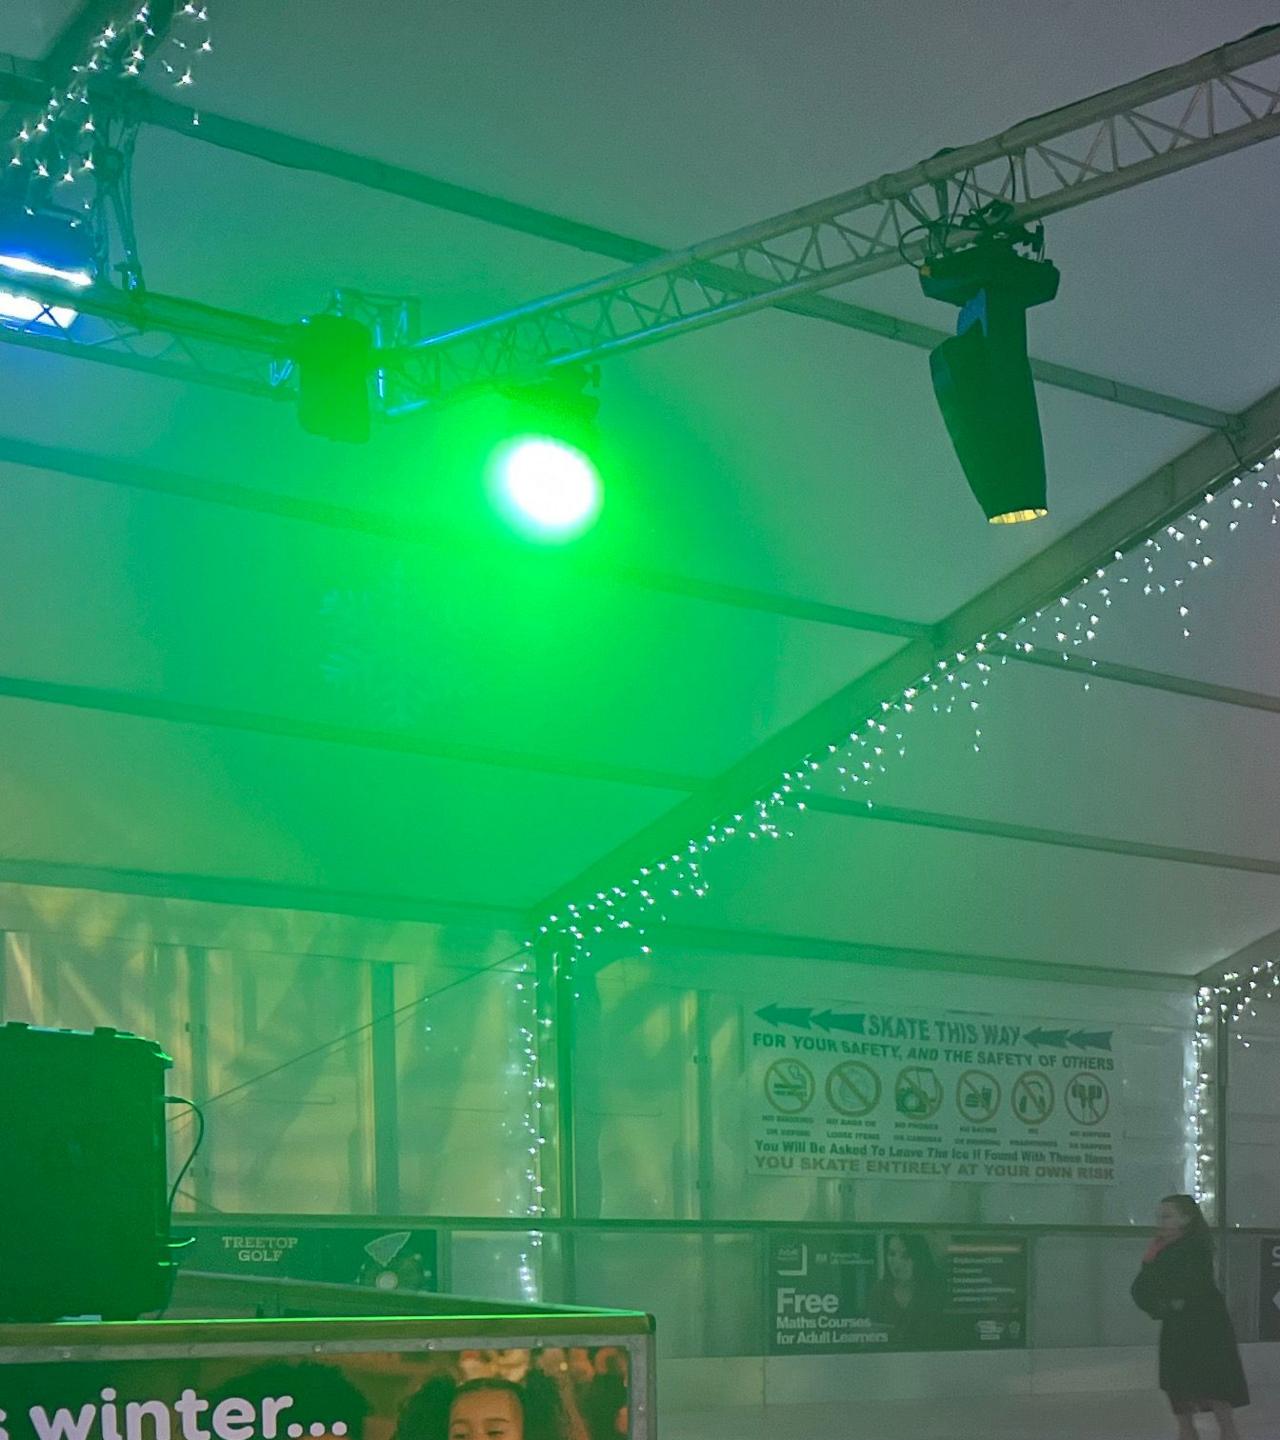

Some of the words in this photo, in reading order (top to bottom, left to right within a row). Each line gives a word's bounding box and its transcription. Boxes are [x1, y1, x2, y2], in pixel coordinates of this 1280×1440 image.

[868, 1013, 930, 1042] SKATE
[934, 1019, 978, 1045] THIS
[982, 1024, 1022, 1047] WAY
[752, 1032, 787, 1049] FOR
[794, 1035, 839, 1053] YOUR
[905, 1046, 939, 1063] AND
[944, 1048, 974, 1066] THE
[977, 1050, 1034, 1068] SAFETY
[1038, 1053, 1058, 1068] OF
[1062, 1054, 1115, 1072] OTHERS
[755, 1140, 779, 1152] You
[783, 1141, 806, 1153] Will
[811, 1142, 826, 1154] Be
[830, 1143, 867, 1156] Asked
[871, 1145, 885, 1156] To
[889, 1146, 923, 1158] Leave
[927, 1147, 948, 1158] The
[952, 1148, 969, 1160] Ice
[985, 1150, 1018, 1162] Found
[1022, 1151, 1046, 1163] With
[1049, 1152, 1082, 1164] These
[754, 1156, 794, 1170] YOU
[800, 1157, 860, 1172] SKATE
[866, 1160, 951, 1175] ENTIRELY
[957, 1163, 978, 1176] AT
[984, 1164, 1030, 1178] YOUR
[1035, 1166, 1073, 1179] OWN
[1077, 1167, 1115, 1180] RISK
[222, 1236, 299, 1249] TREETOP
[238, 1250, 283, 1262] GOLF
[776, 1287, 840, 1314] Free
[776, 1316, 817, 1329] Maths
[818, 1316, 872, 1329] Courses
[776, 1331, 794, 1345] for
[796, 1331, 832, 1344] Adult
[833, 1331, 889, 1344] Learners
